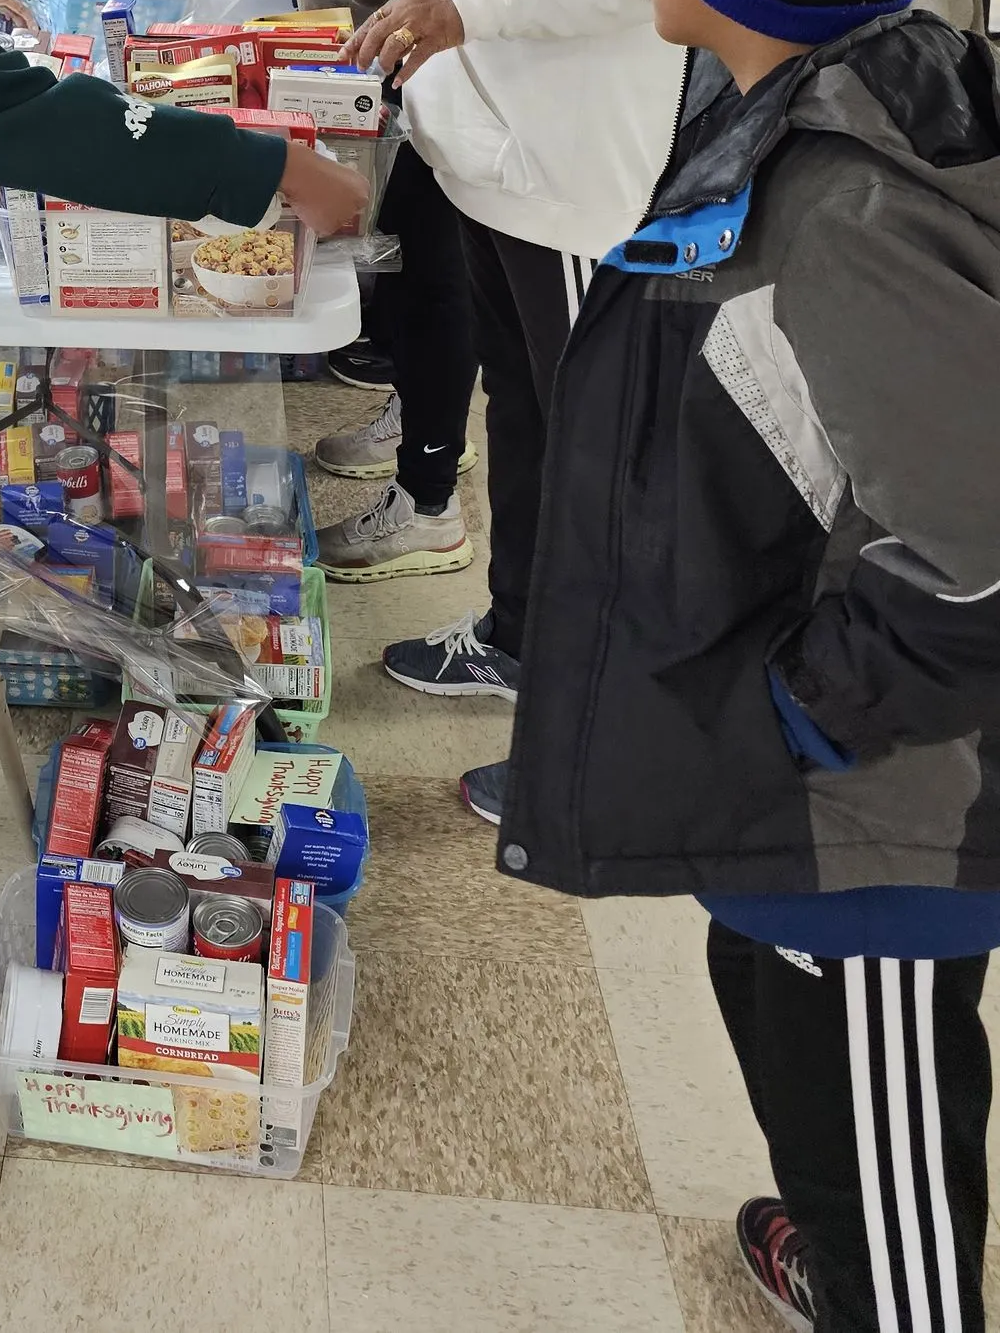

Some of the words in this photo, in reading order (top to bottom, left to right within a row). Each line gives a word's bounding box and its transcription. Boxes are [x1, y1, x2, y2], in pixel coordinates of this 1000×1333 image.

[135, 79, 172, 93] IDAHOAN
[292, 759, 333, 796] Happy
[176, 859, 208, 872] Turkey
[122, 922, 145, 937] Nutrition
[145, 930, 163, 938] Facts
[275, 915, 283, 933] Super
[163, 968, 218, 983] HOMEMADE
[170, 978, 194, 987] BAKING
[271, 983, 288, 992] Super
[273, 1007, 301, 1019] Betty's
[166, 1013, 207, 1031] Simply
[153, 1022, 222, 1040] HOMEMADE
[33, 1039, 43, 1058] Ham
[163, 1036, 194, 1046] BAKING
[195, 1039, 210, 1047] MIX
[155, 1046, 219, 1062] CORNBREAD
[41, 1096, 173, 1138] Thanksgiving
